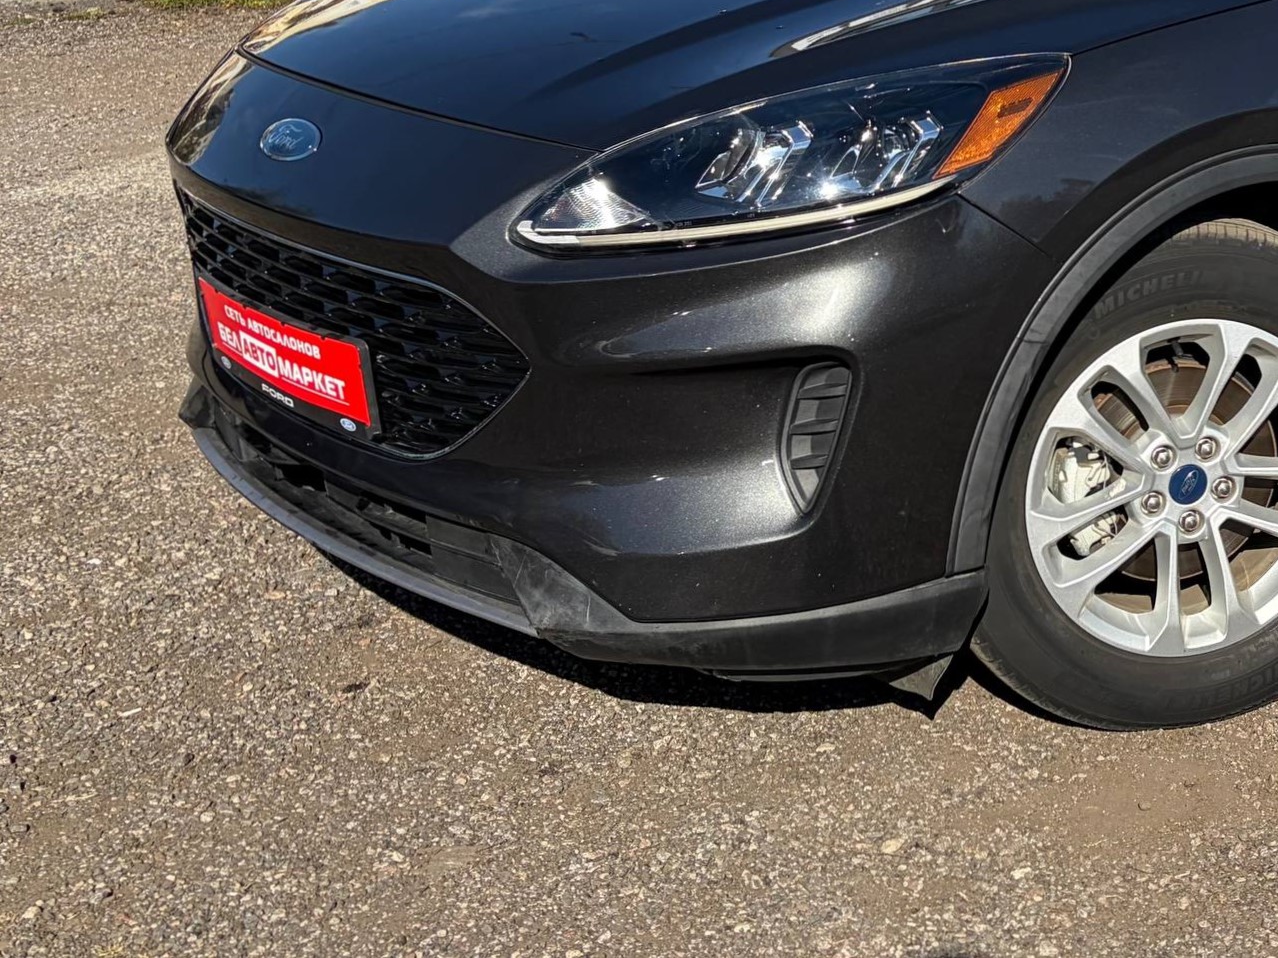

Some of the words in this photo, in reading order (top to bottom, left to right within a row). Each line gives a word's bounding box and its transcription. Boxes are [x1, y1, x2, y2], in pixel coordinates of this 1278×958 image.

[223, 304, 247, 327] СЕТЬ
[247, 317, 321, 360] АВТОСАЛОНОВ
[217, 321, 242, 352] БЕЛ
[242, 339, 277, 372] АВТО
[278, 355, 346, 400] МАРКЕТ
[261, 383, 295, 408] FORD
